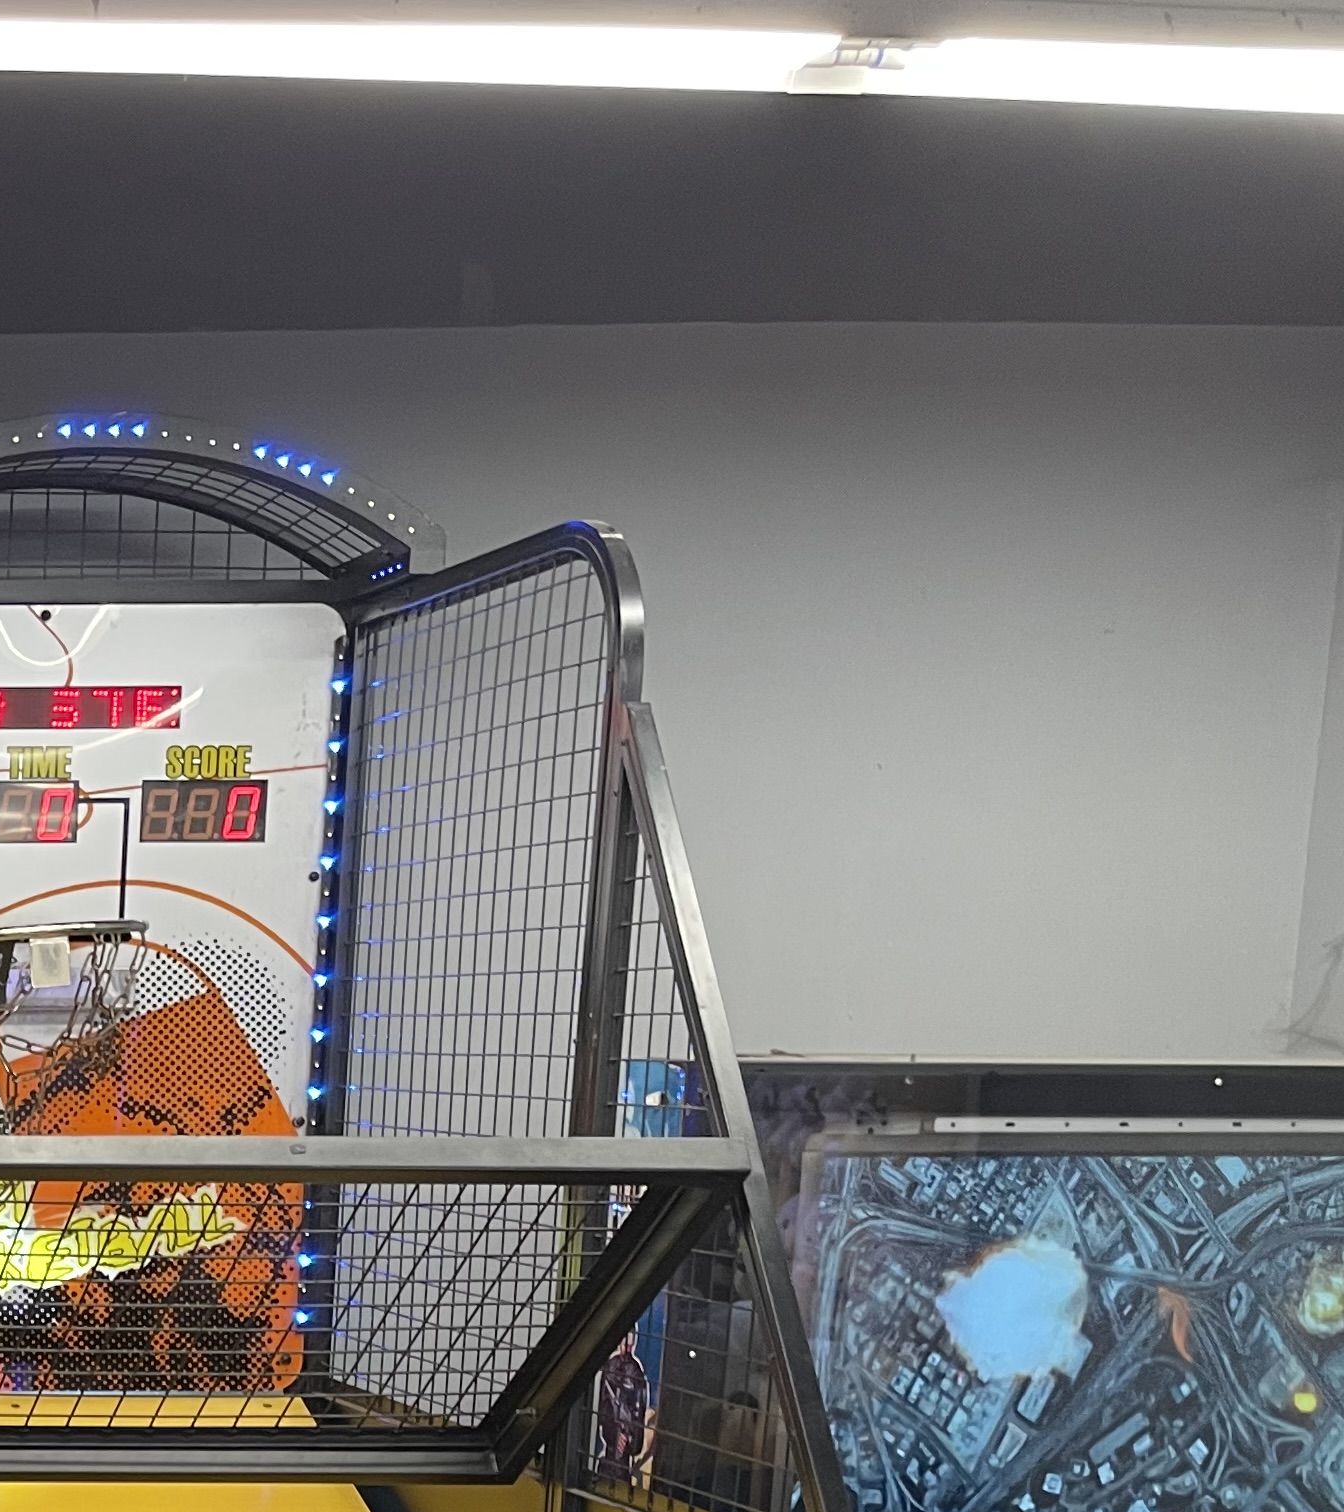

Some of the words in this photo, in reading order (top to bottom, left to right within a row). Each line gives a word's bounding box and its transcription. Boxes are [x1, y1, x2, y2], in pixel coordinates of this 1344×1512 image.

[7, 746, 73, 780] TIME
[166, 745, 252, 780] SCORE
[36, 787, 75, 841] 0
[221, 785, 262, 840] 0
